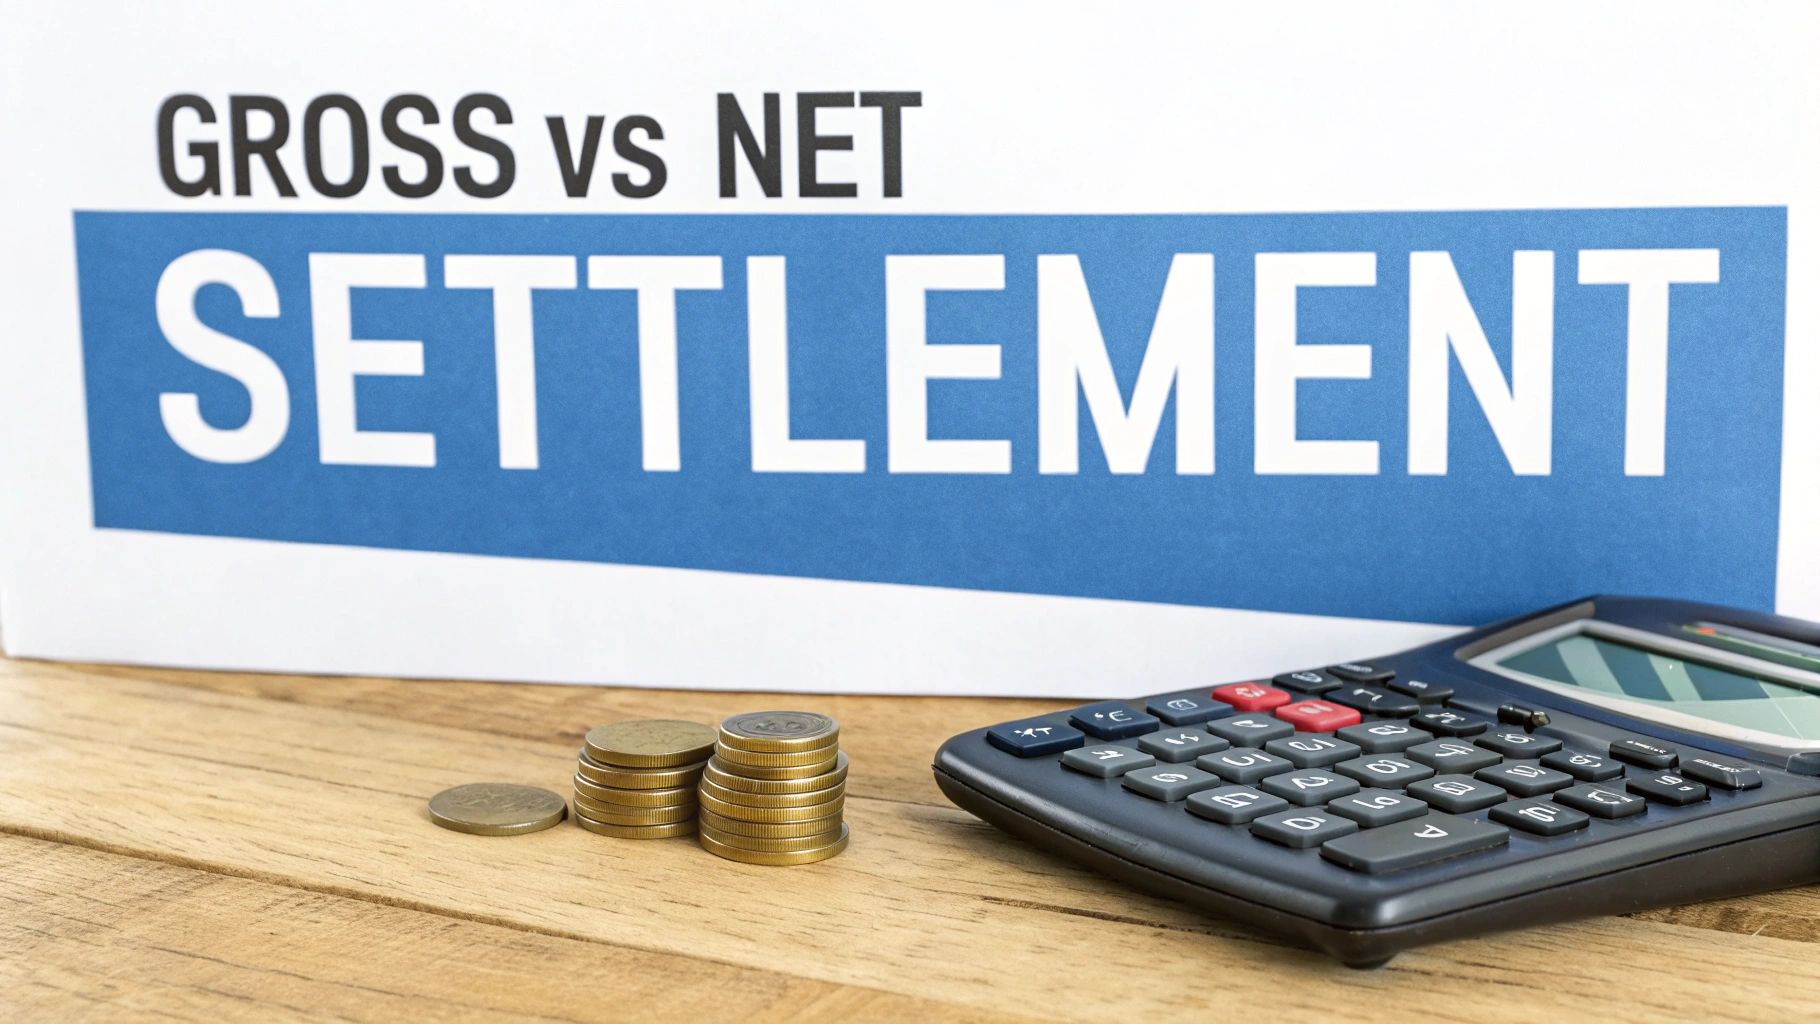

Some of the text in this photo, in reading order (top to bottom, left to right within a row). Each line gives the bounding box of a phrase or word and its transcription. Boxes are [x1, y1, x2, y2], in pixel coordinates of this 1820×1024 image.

[157, 91, 922, 199] GROSS vs NET
[155, 247, 1721, 477] SETTLEMENT
